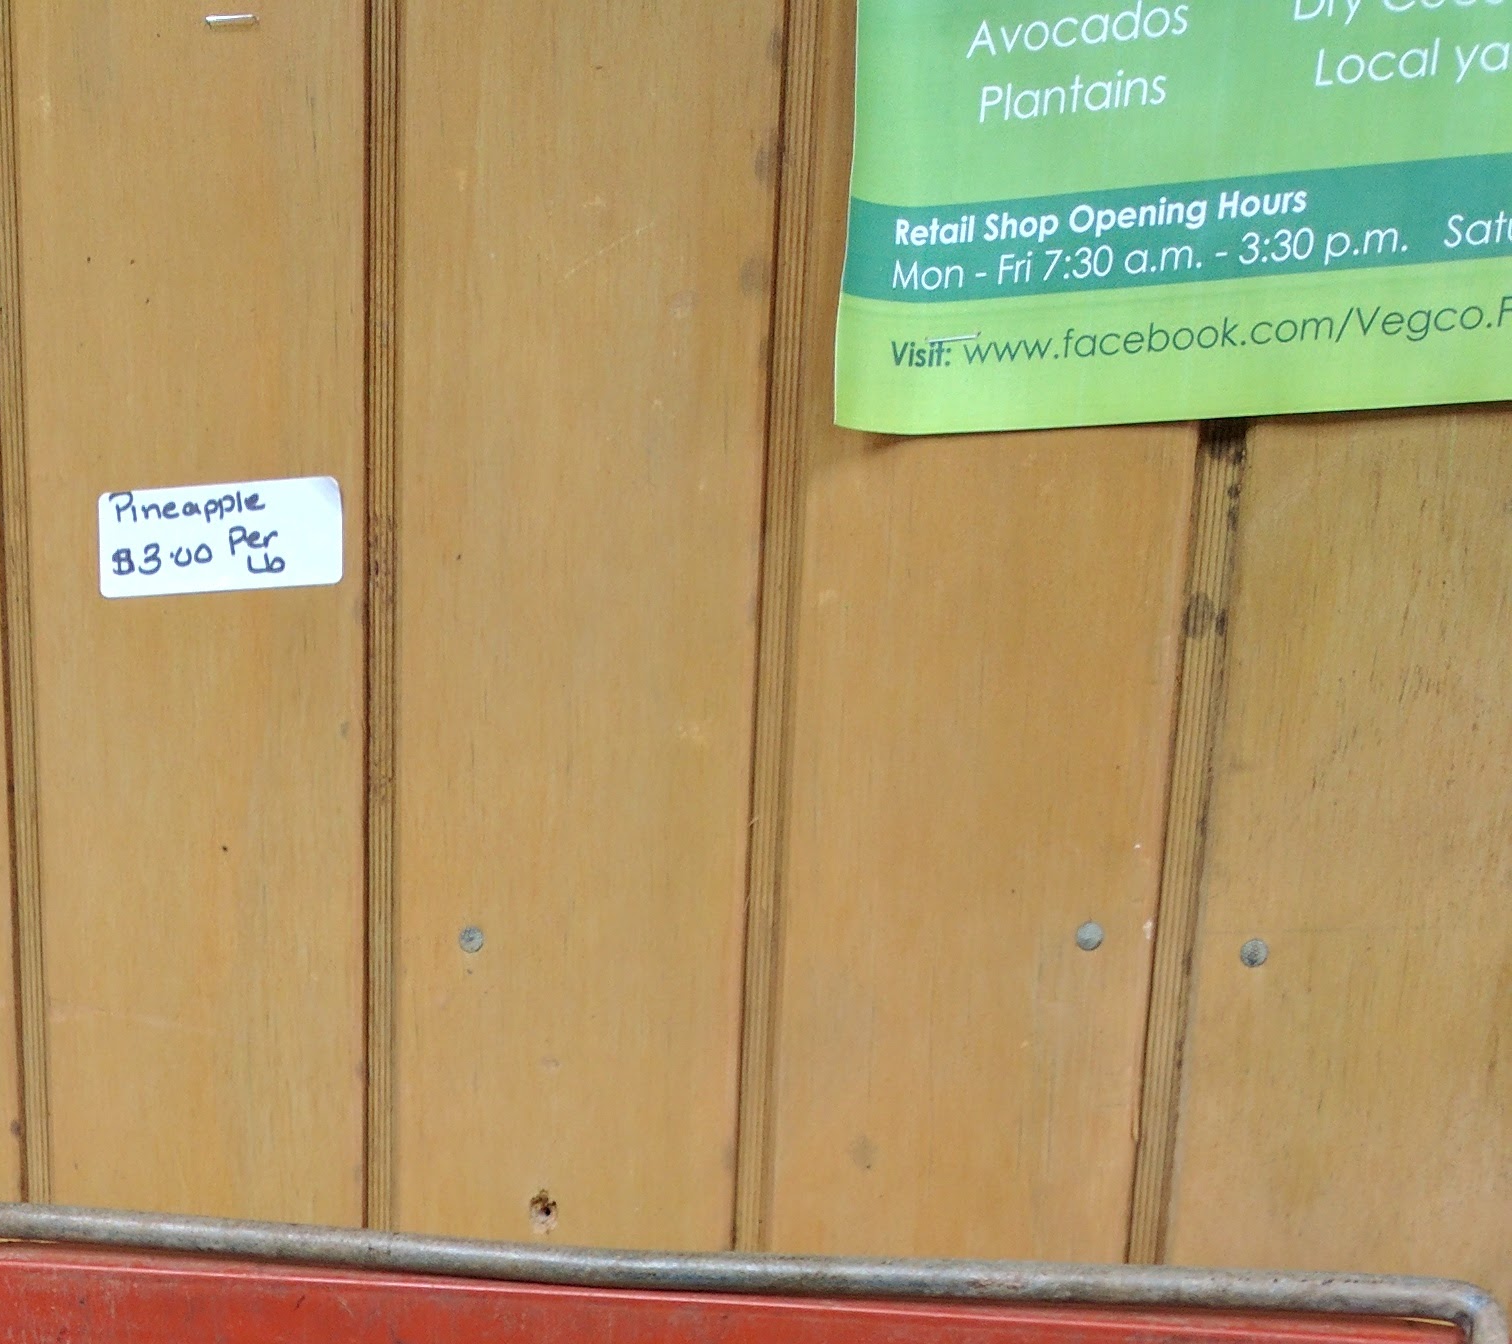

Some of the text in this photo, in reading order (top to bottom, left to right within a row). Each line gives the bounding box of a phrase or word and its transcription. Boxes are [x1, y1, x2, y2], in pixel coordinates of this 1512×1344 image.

[966, 0, 1189, 59] Avocados
[1315, 37, 1441, 87] Local
[979, 69, 1167, 123] Plantains
[895, 189, 1308, 246] Retail Shop Opening Hours
[892, 259, 964, 291] Mon
[997, 250, 1034, 285] Fri
[1043, 244, 1114, 281] 7:30
[1124, 244, 1203, 275] a.m.
[1238, 227, 1315, 266] 3:30
[1324, 226, 1409, 266] p.m.
[891, 341, 951, 368] Visit:
[108, 490, 266, 523] Pineapple
[228, 525, 278, 556] Per
